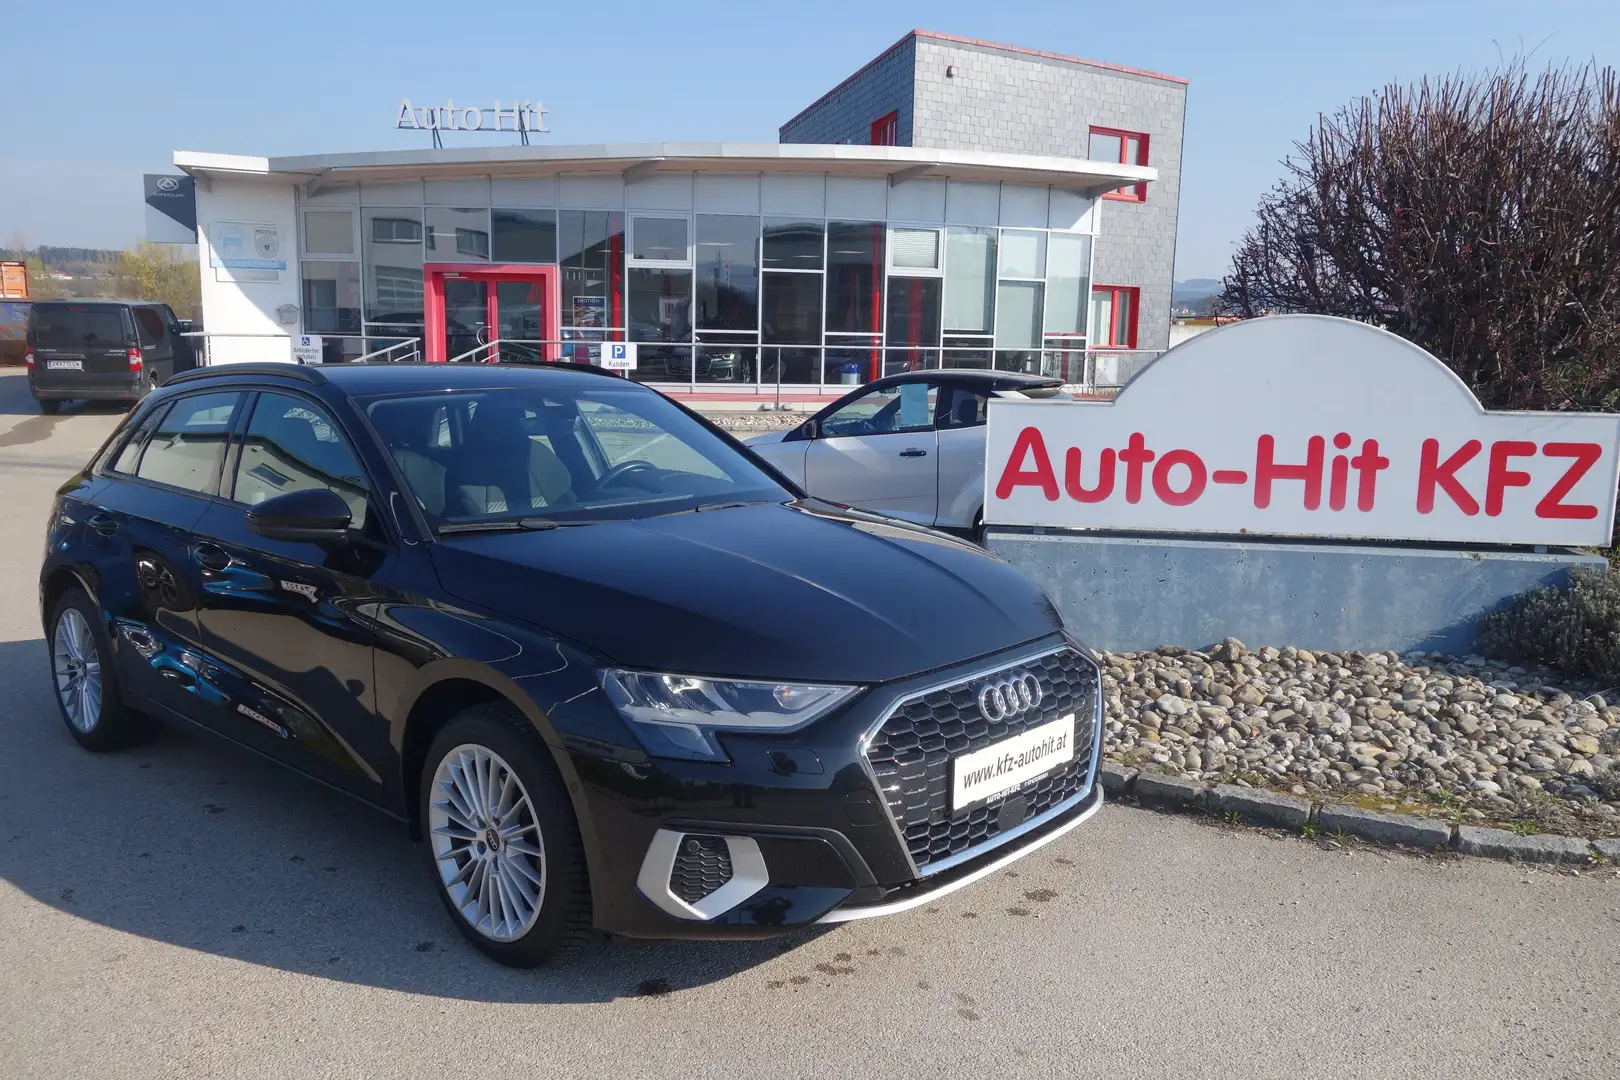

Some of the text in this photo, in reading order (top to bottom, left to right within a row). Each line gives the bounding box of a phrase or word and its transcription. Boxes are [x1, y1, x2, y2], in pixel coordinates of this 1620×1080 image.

[396, 98, 550, 132] Auto Hit
[608, 360, 630, 368] Kunden
[995, 426, 1603, 520] Auto-Hit KFZ
[963, 731, 1068, 790] www.kfz-autohit.at
